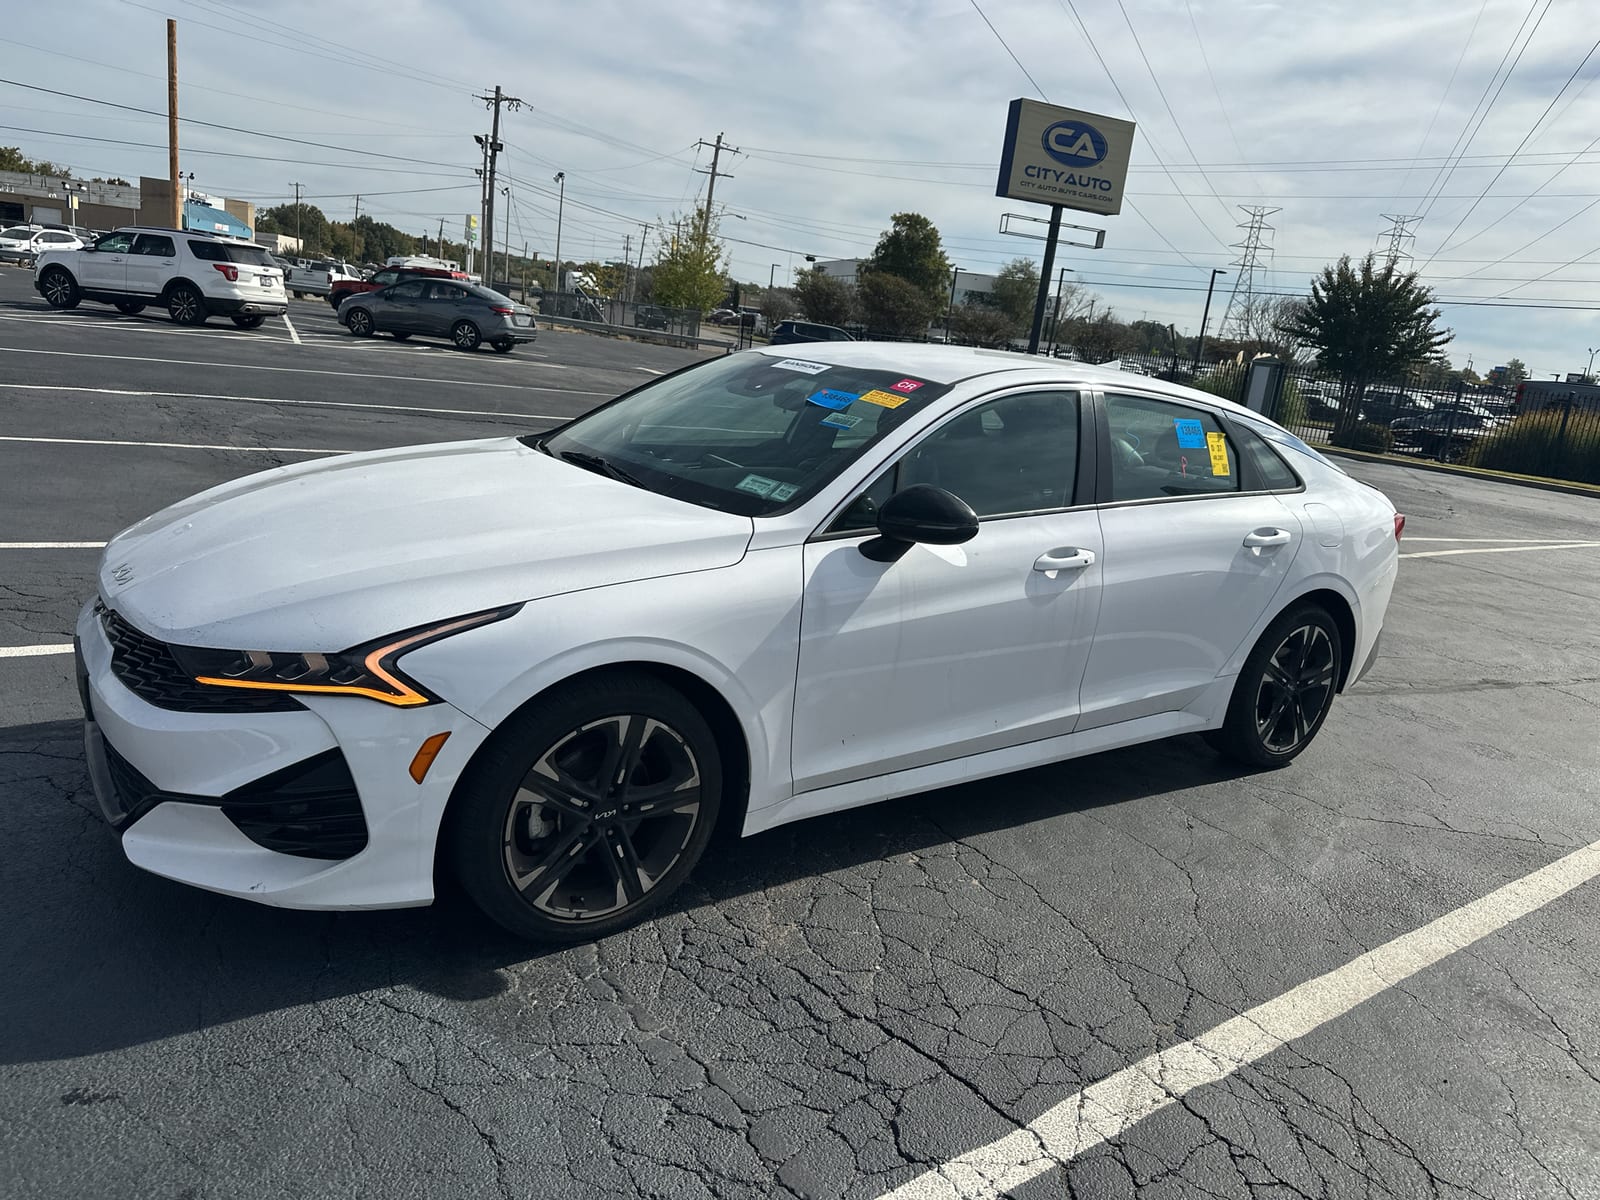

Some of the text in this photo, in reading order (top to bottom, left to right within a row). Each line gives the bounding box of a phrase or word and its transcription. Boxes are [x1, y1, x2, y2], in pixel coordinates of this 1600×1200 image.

[1048, 127, 1098, 160] CA
[1020, 180, 1113, 203] CITY AUTO BUYS CARS.COM
[897, 381, 916, 391] CR
